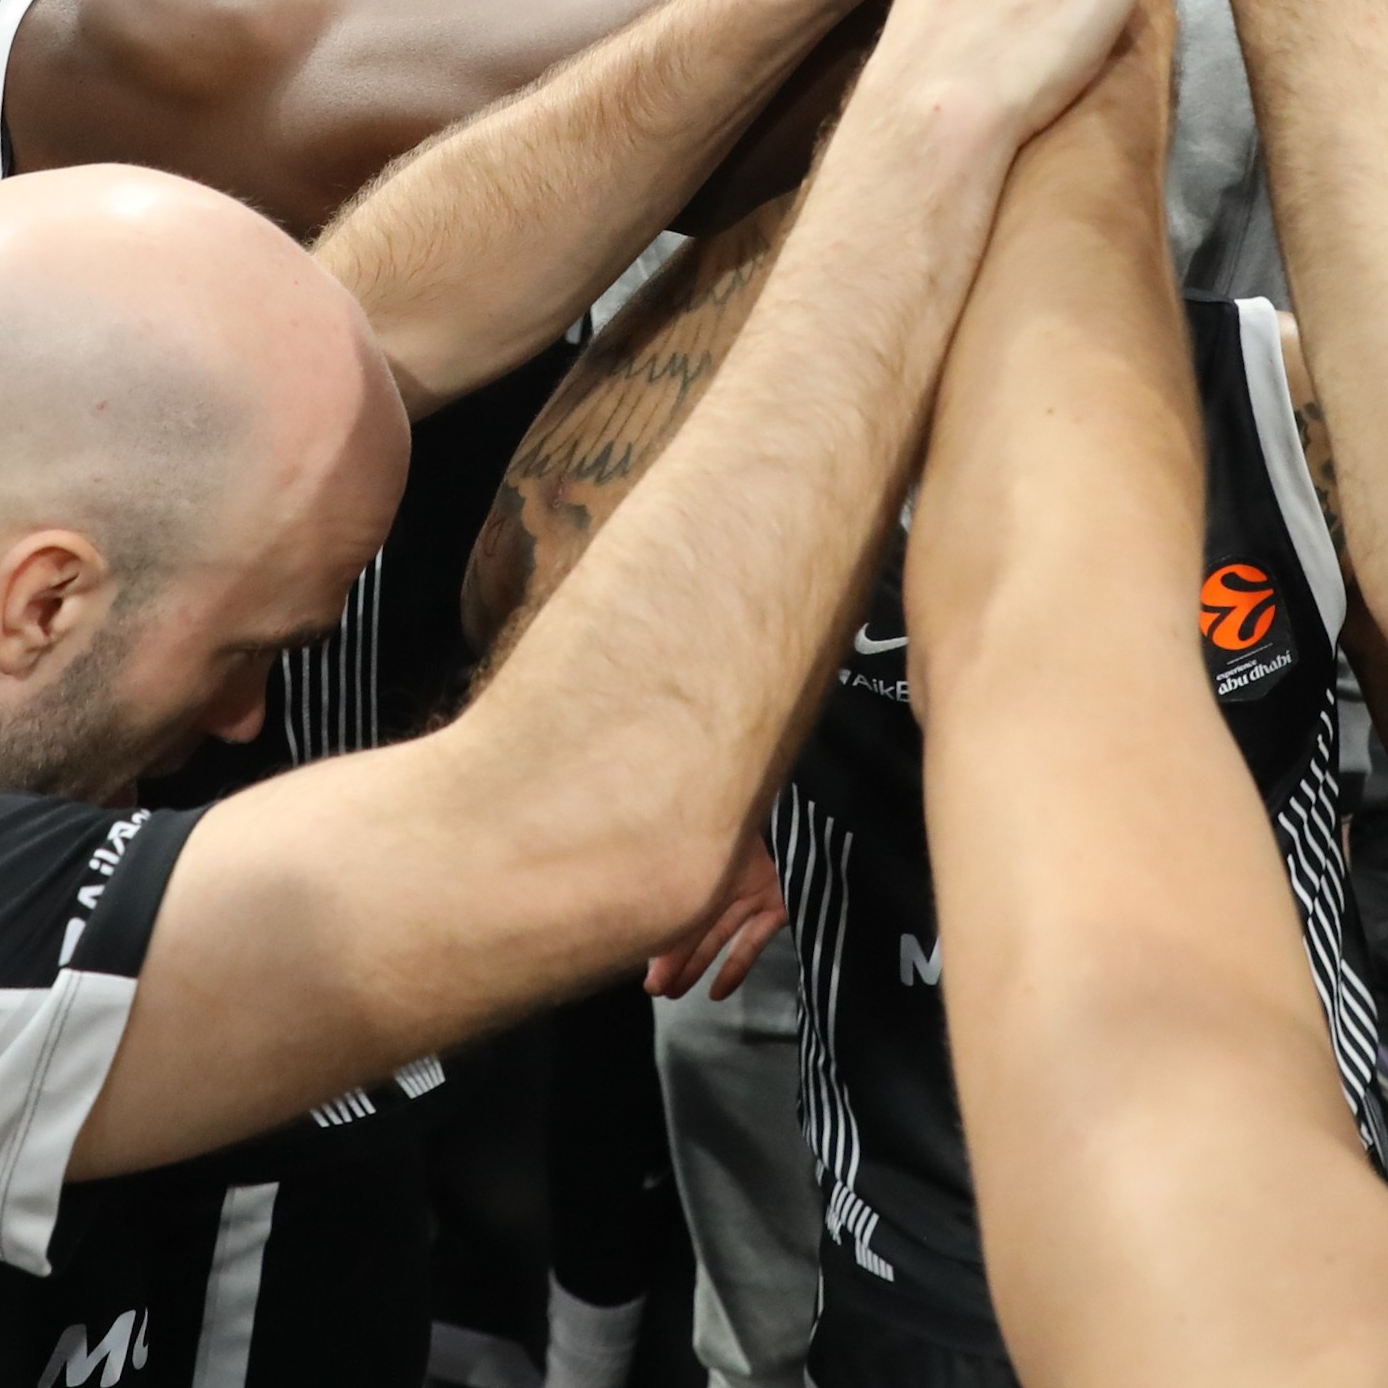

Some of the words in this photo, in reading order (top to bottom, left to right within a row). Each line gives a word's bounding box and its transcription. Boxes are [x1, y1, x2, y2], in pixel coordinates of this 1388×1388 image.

[1216, 659, 1258, 681] experience
[1217, 674, 1251, 695] abu
[1249, 650, 1292, 682] dhabi
